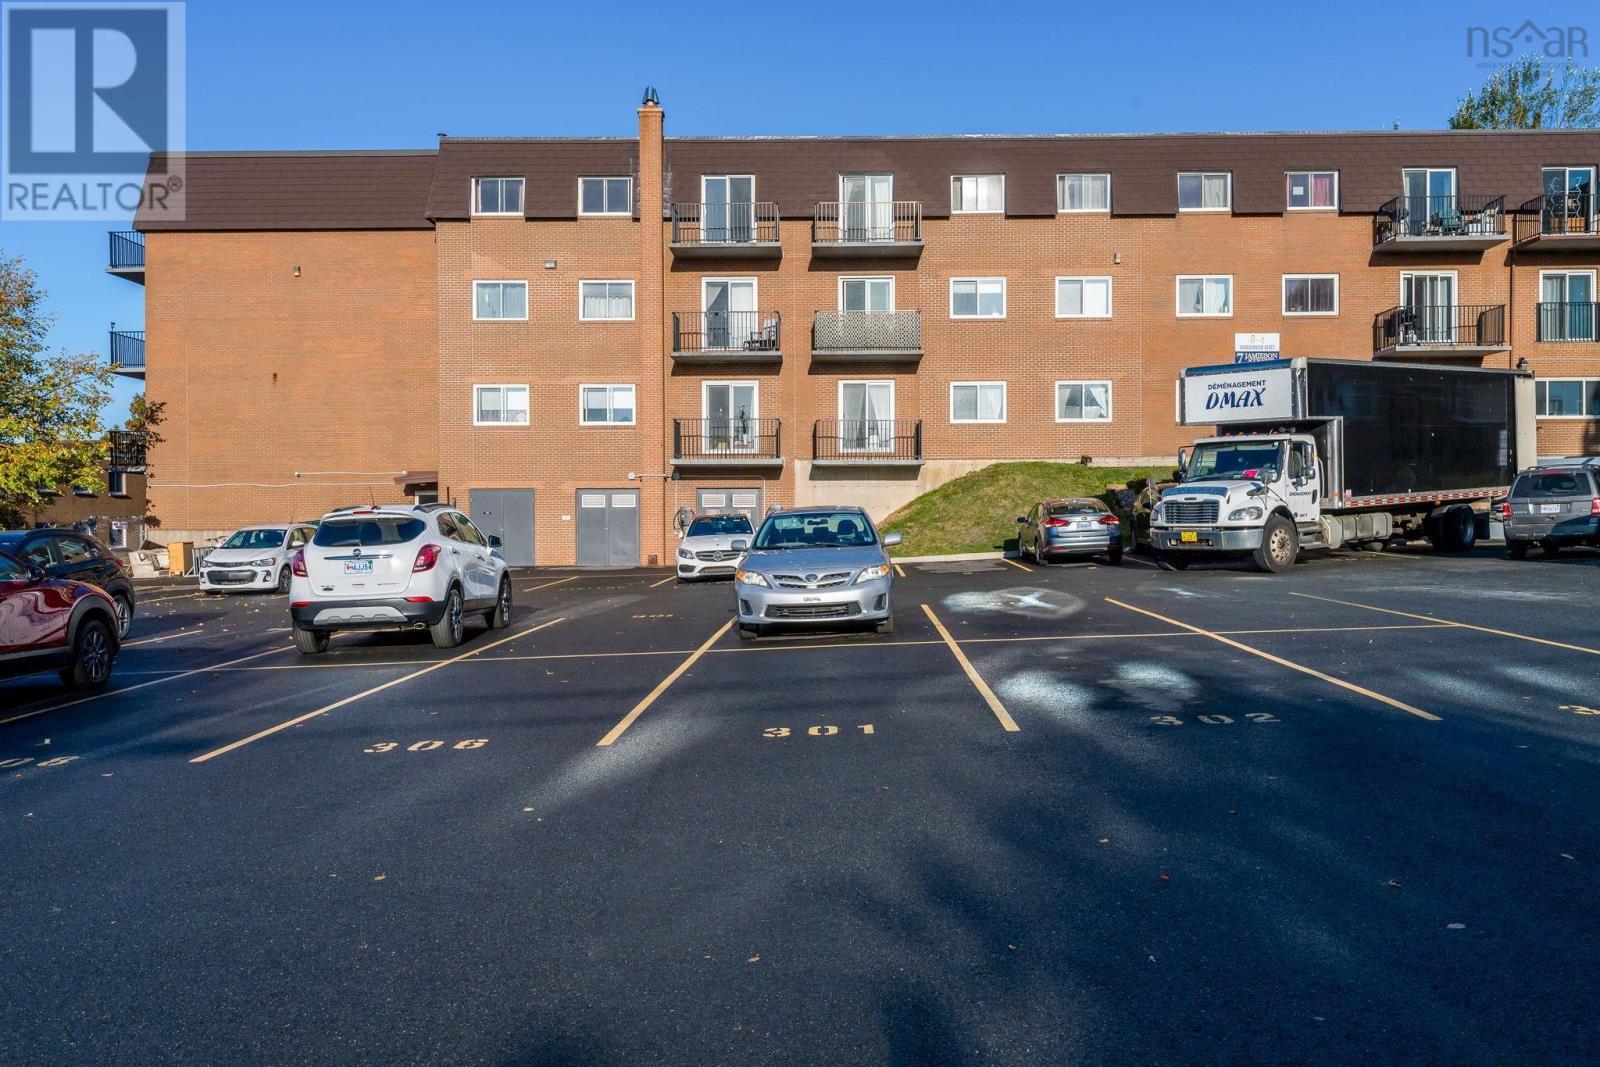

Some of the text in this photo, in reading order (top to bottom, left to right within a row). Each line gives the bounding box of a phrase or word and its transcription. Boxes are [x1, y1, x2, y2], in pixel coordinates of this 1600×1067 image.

[1236, 353, 1243, 363] 7
[1207, 379, 1267, 390] DÉMÉNAGEMENT
[1205, 388, 1267, 410] DMAX
[1150, 712, 1281, 725] 302
[762, 724, 875, 738] 301
[363, 738, 489, 753] 306
